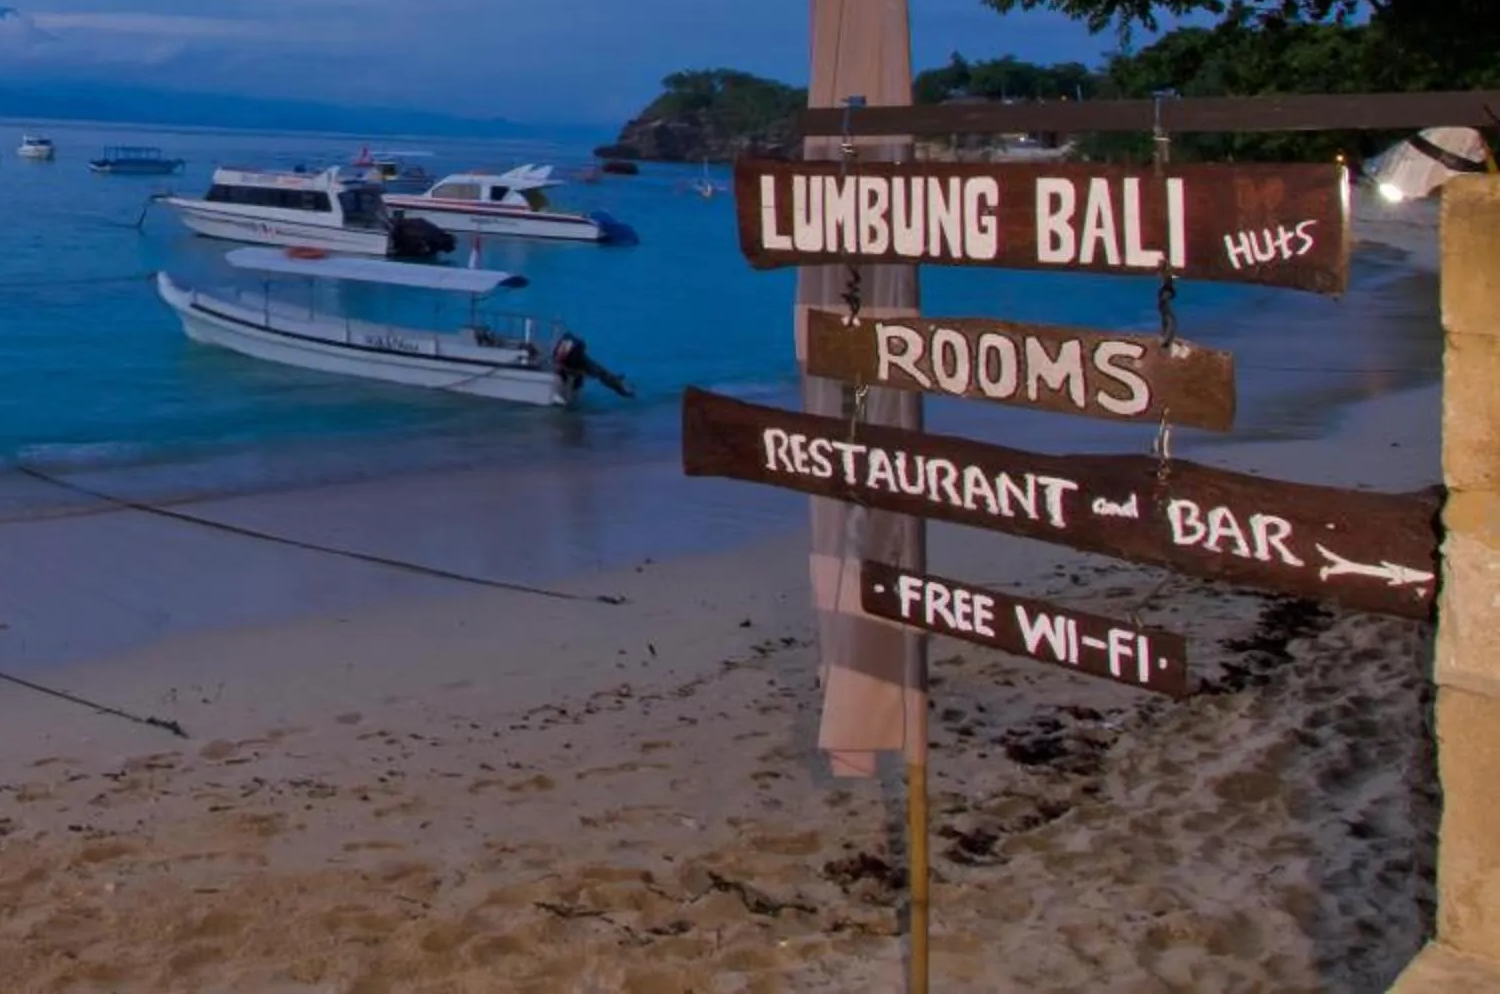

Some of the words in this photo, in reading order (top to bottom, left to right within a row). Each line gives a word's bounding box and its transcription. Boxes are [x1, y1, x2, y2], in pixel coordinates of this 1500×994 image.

[759, 174, 998, 261] LUMBUNG
[1036, 177, 1186, 269] BALI
[875, 323, 1151, 416] ROOMS
[764, 427, 1078, 528] RESTAURANT
[1092, 494, 1138, 520] and
[1167, 499, 1304, 567] BAR
[898, 575, 996, 638] FREE
[1014, 605, 1150, 683] WI-FI
